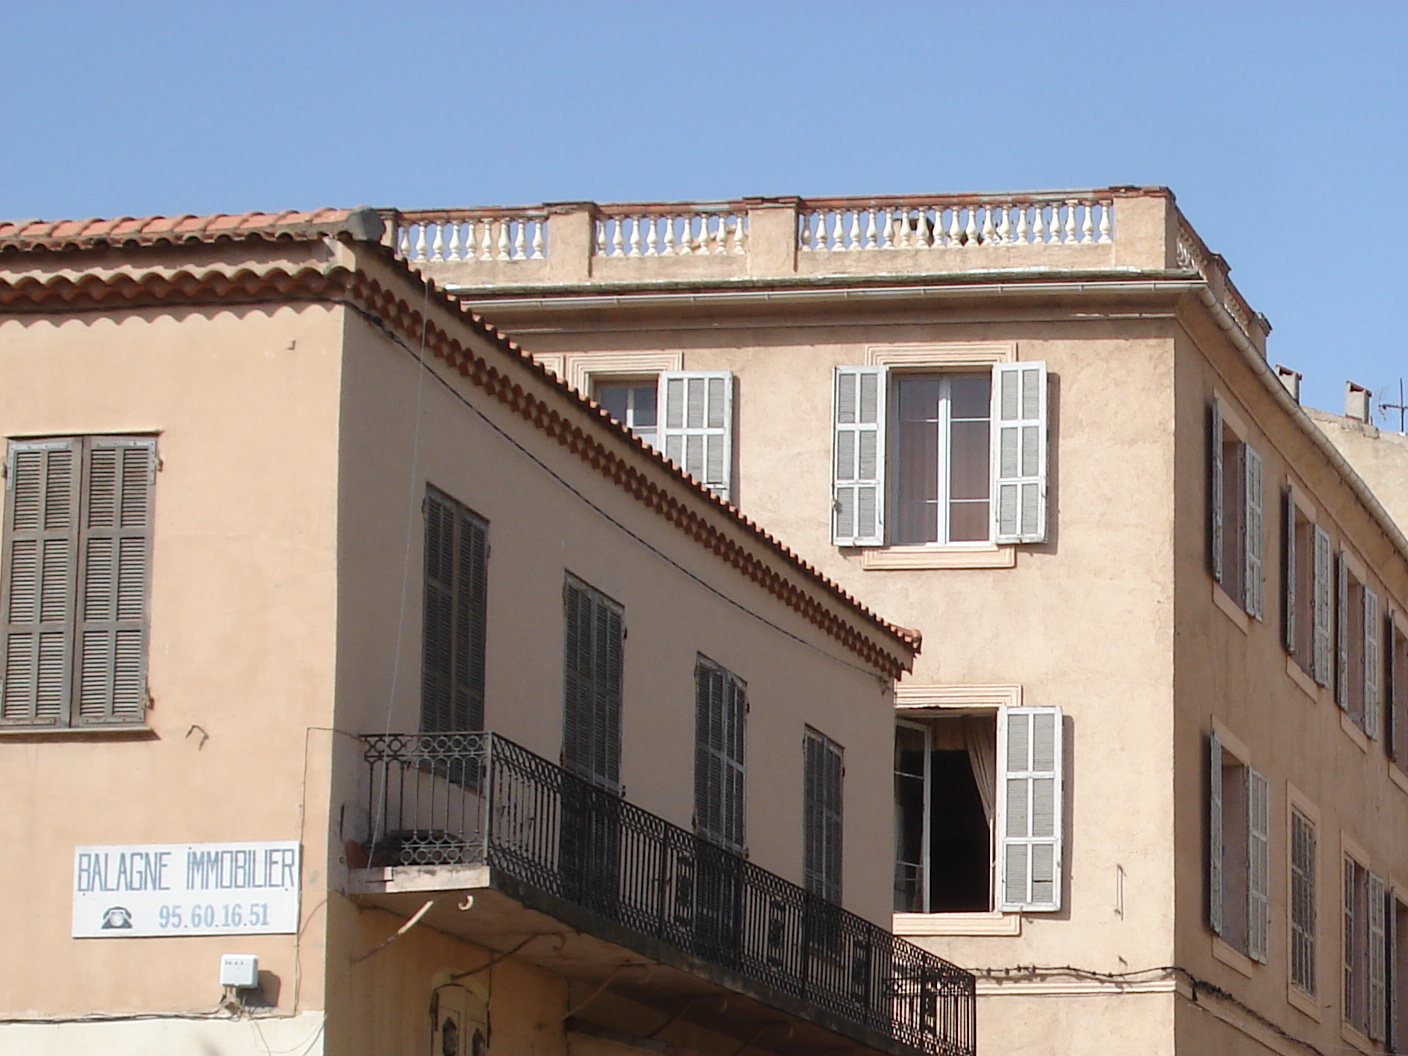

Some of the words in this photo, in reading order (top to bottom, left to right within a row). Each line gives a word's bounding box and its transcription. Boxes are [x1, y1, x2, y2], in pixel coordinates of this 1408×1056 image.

[77, 852, 171, 892] BALAGNE
[186, 849, 295, 889] IMMOBILIER
[159, 903, 270, 928] 95.60.16.51
